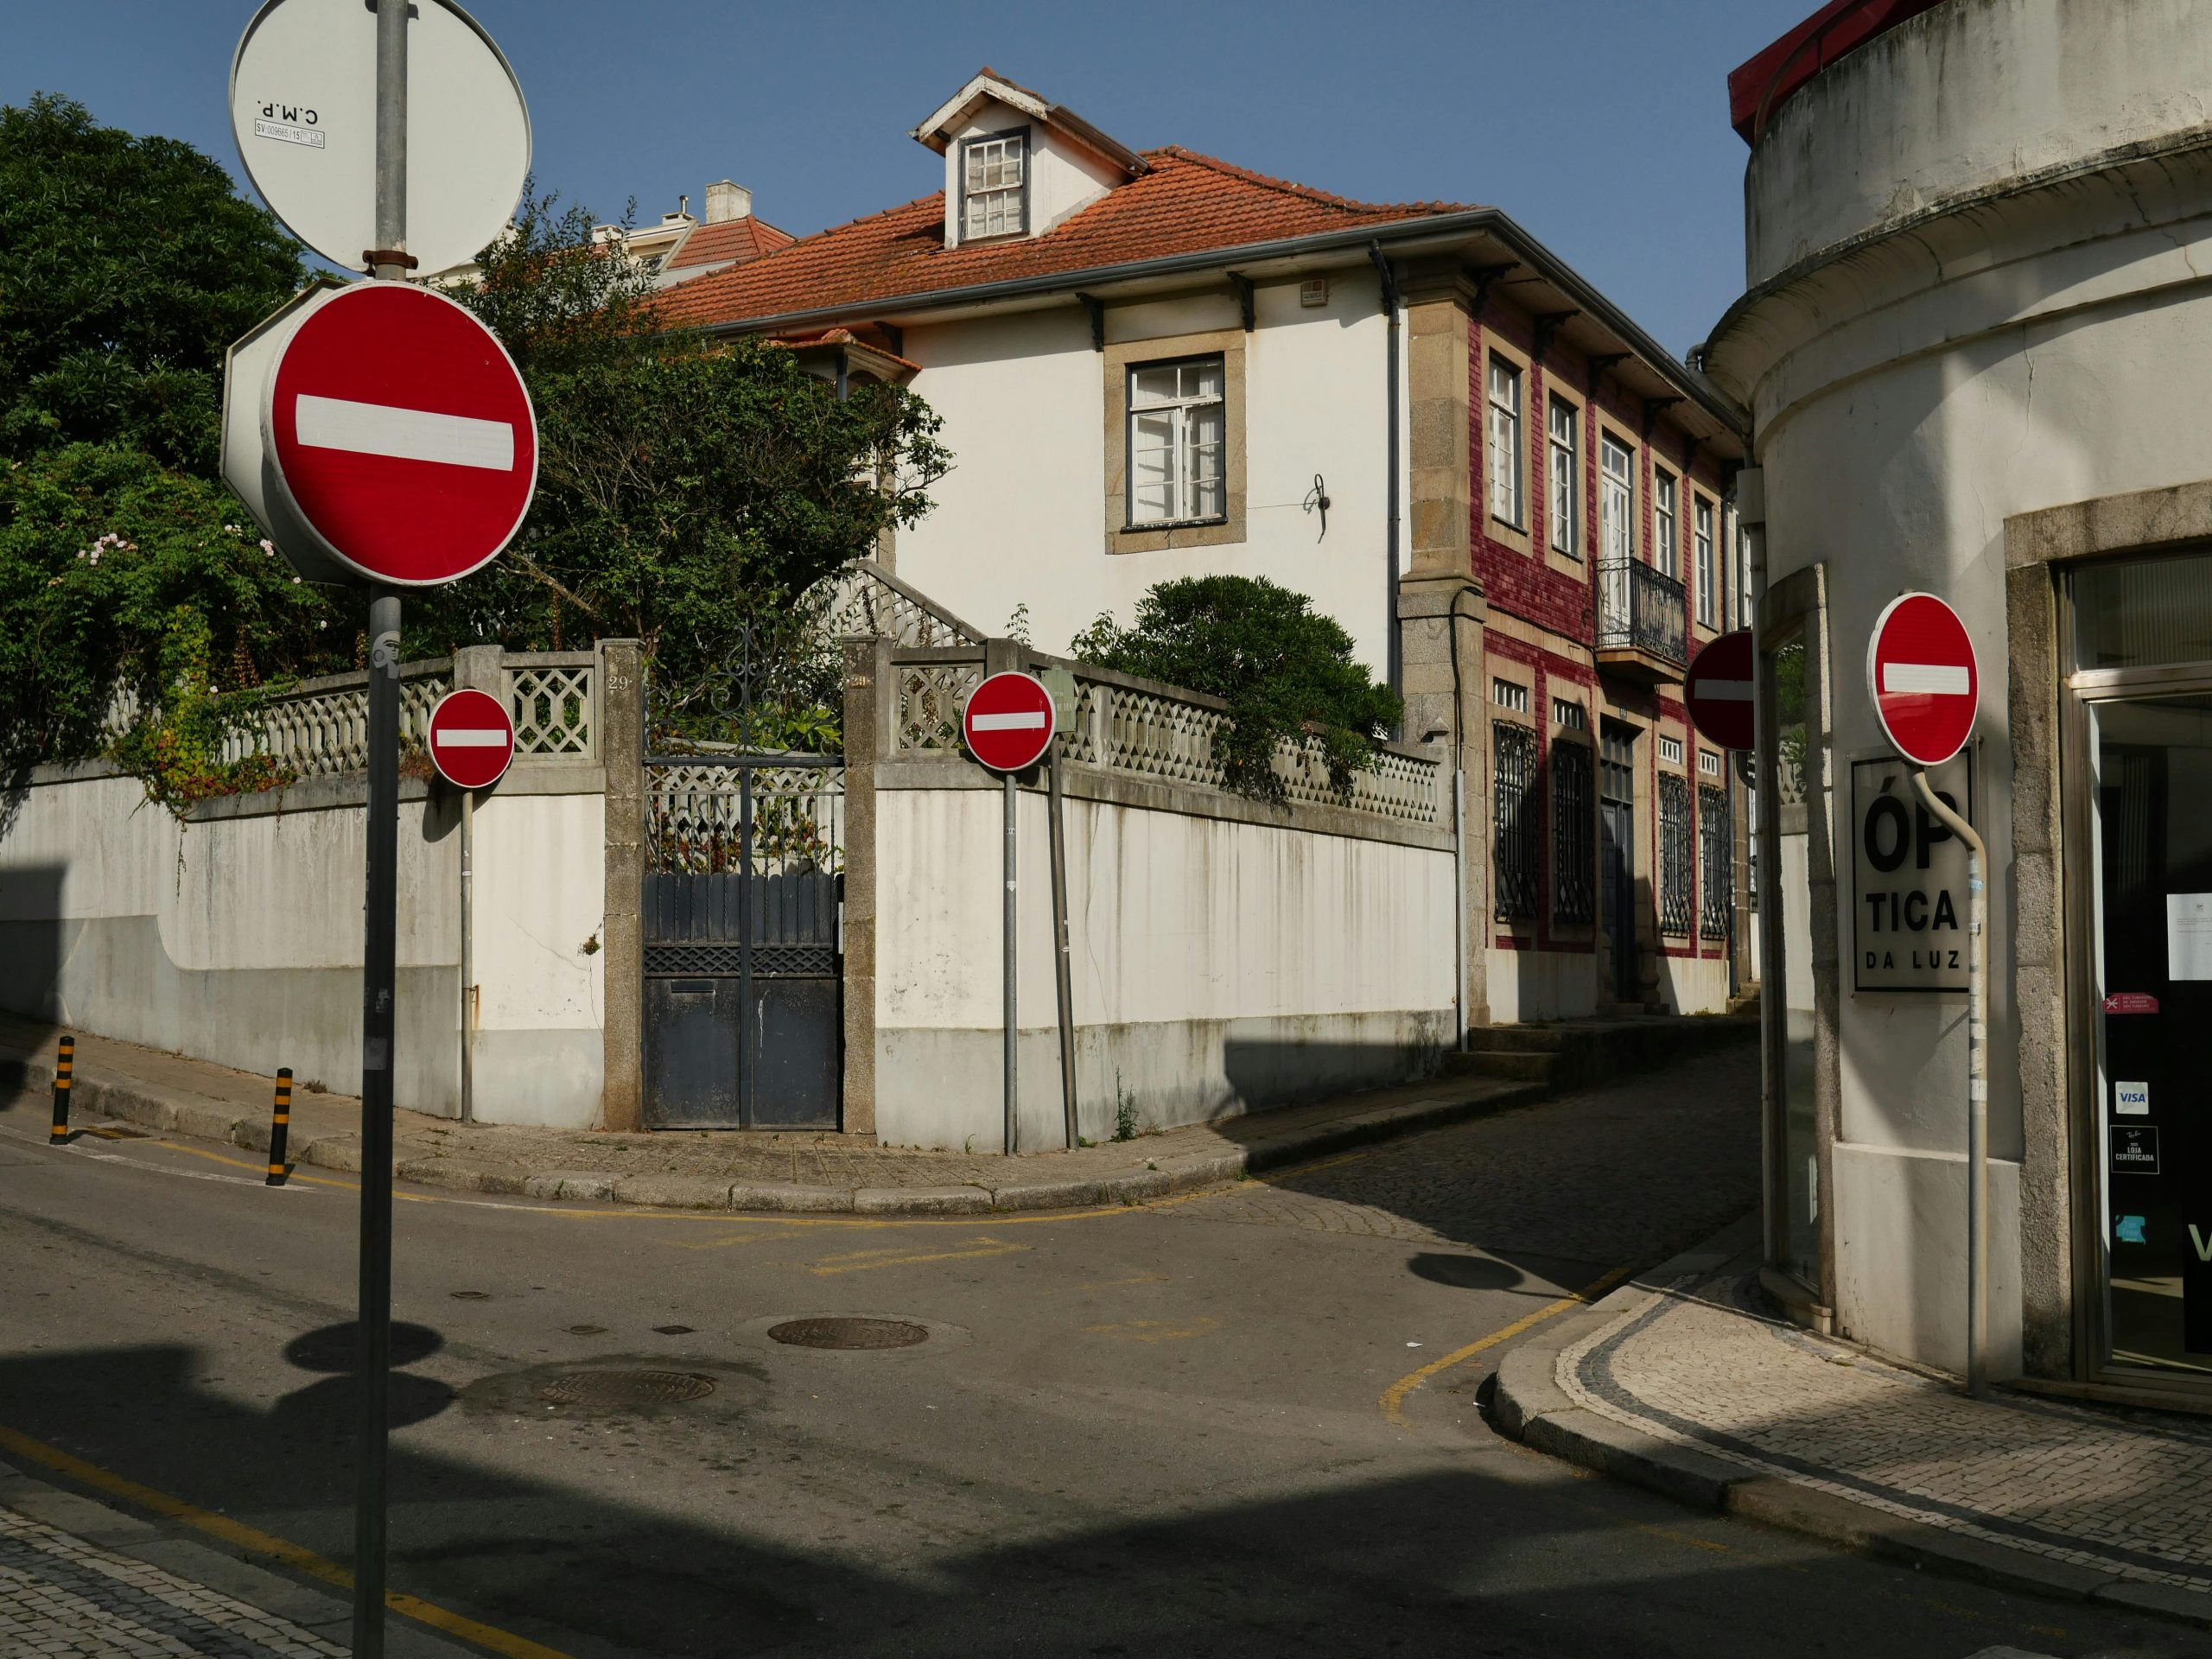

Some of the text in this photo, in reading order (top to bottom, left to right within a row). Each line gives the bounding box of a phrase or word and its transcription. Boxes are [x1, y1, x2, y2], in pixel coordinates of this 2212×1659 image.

[257, 100, 318, 125] C.M.P.
[1864, 776, 1958, 873] ÓP
[1866, 890, 1959, 932] TICA
[1866, 950, 1960, 969] DA LUZ
[2119, 1092, 2146, 1103] VISA
[2115, 1153, 2155, 1162] CERTIFICADA
